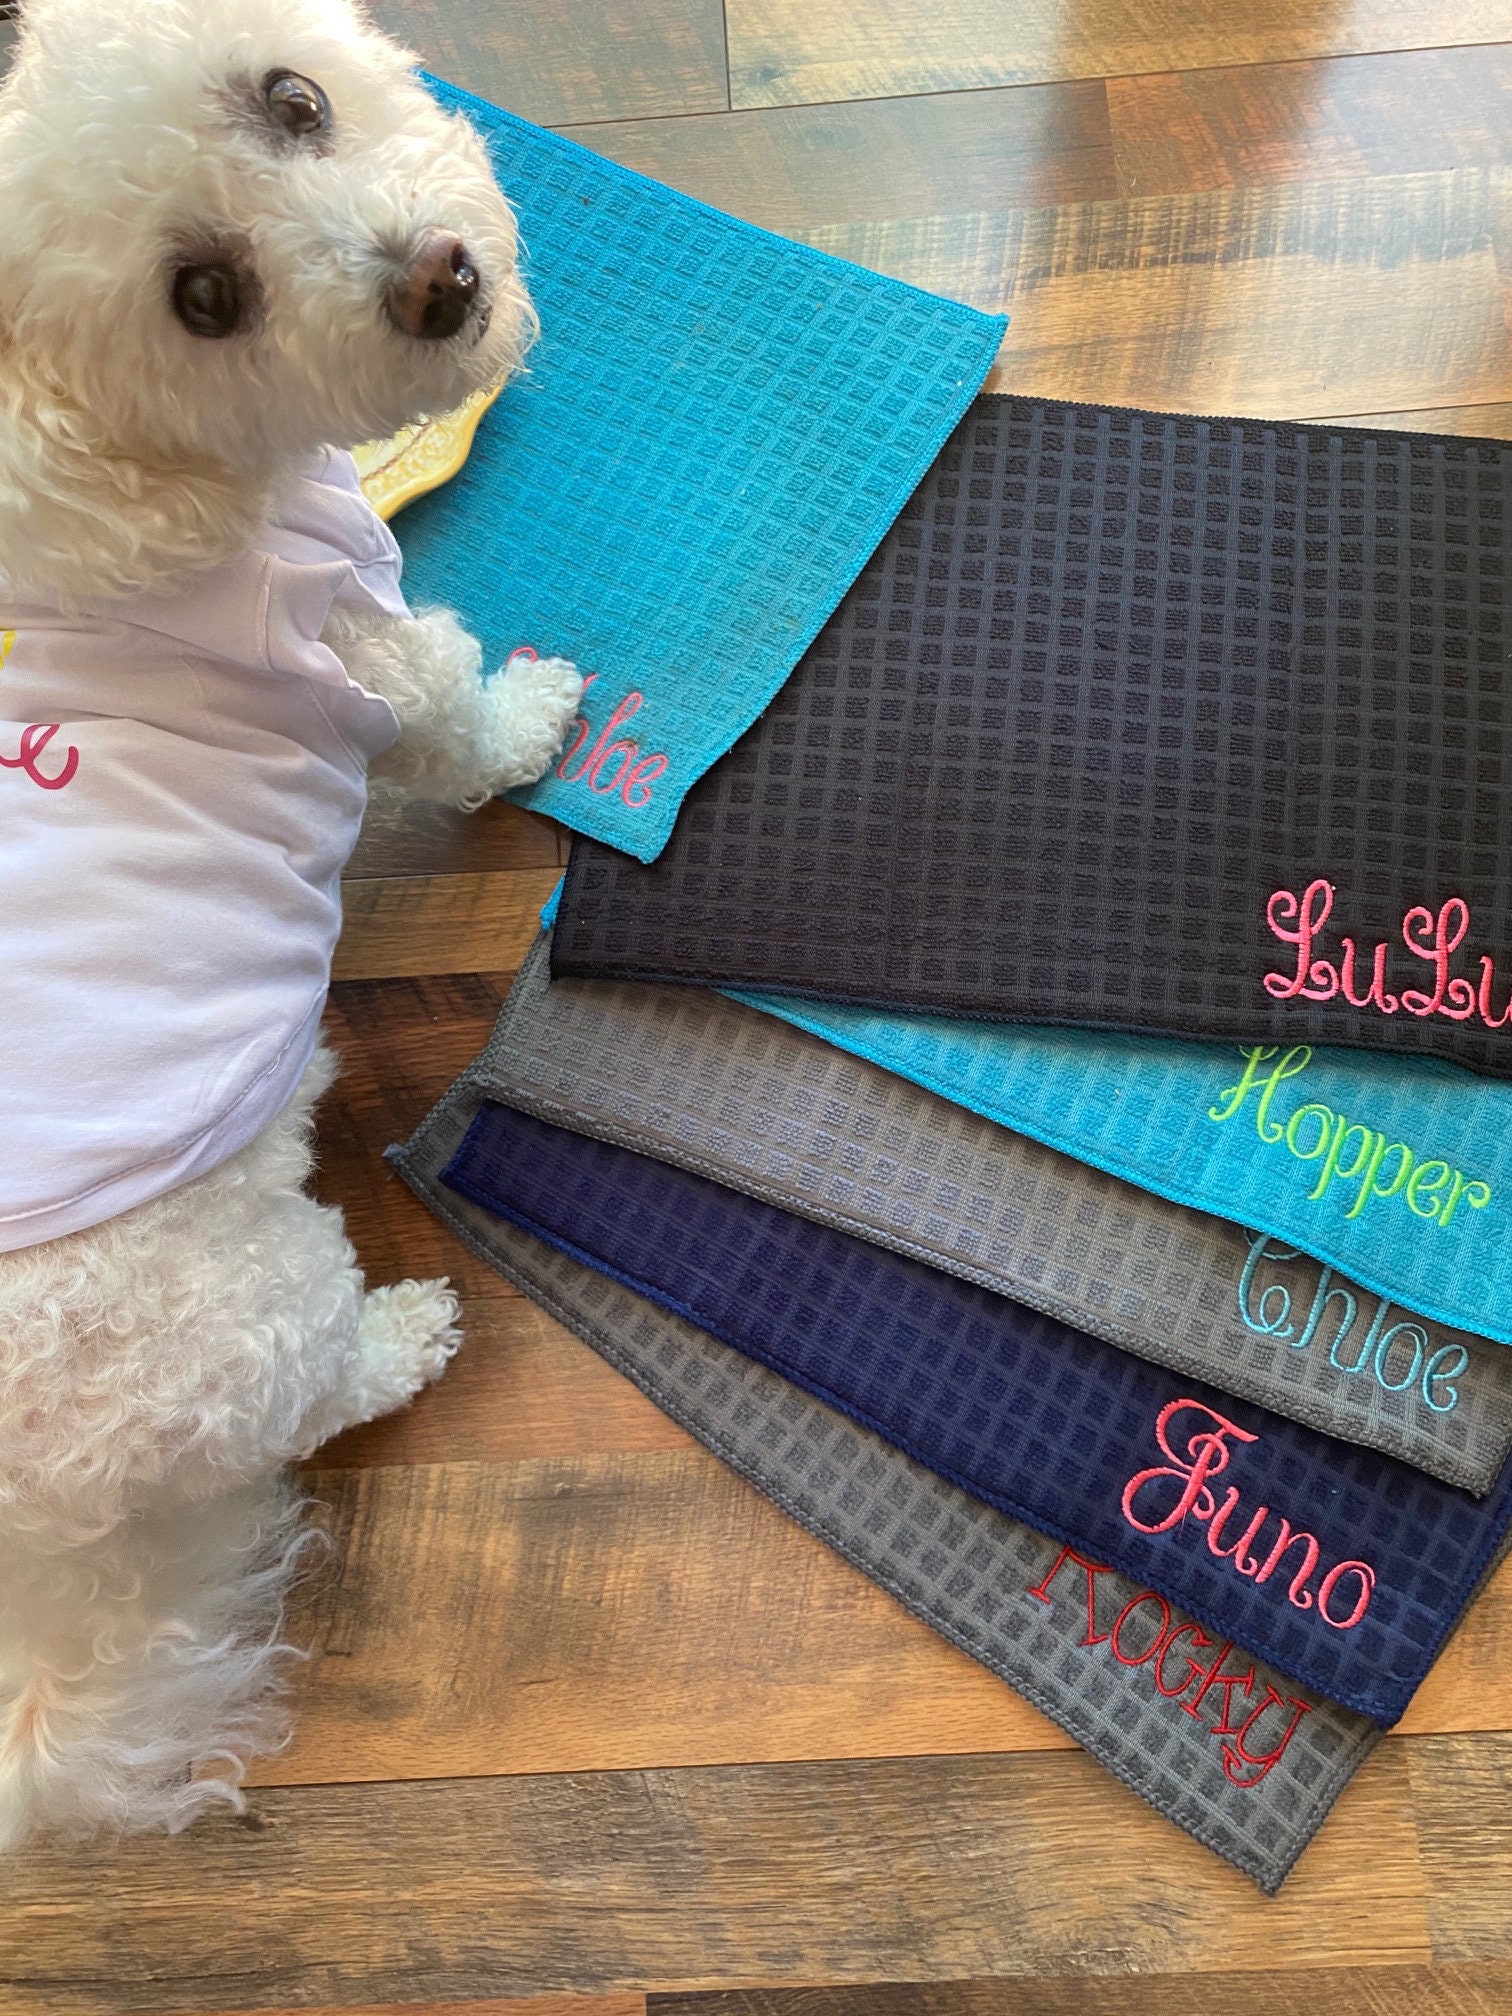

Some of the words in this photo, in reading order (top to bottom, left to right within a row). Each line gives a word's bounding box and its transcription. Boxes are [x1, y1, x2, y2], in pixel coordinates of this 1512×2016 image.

[1208, 1044, 1492, 1227] Hopper
[1238, 1226, 1469, 1412] Chloe
[1121, 1399, 1376, 1629] Juno
